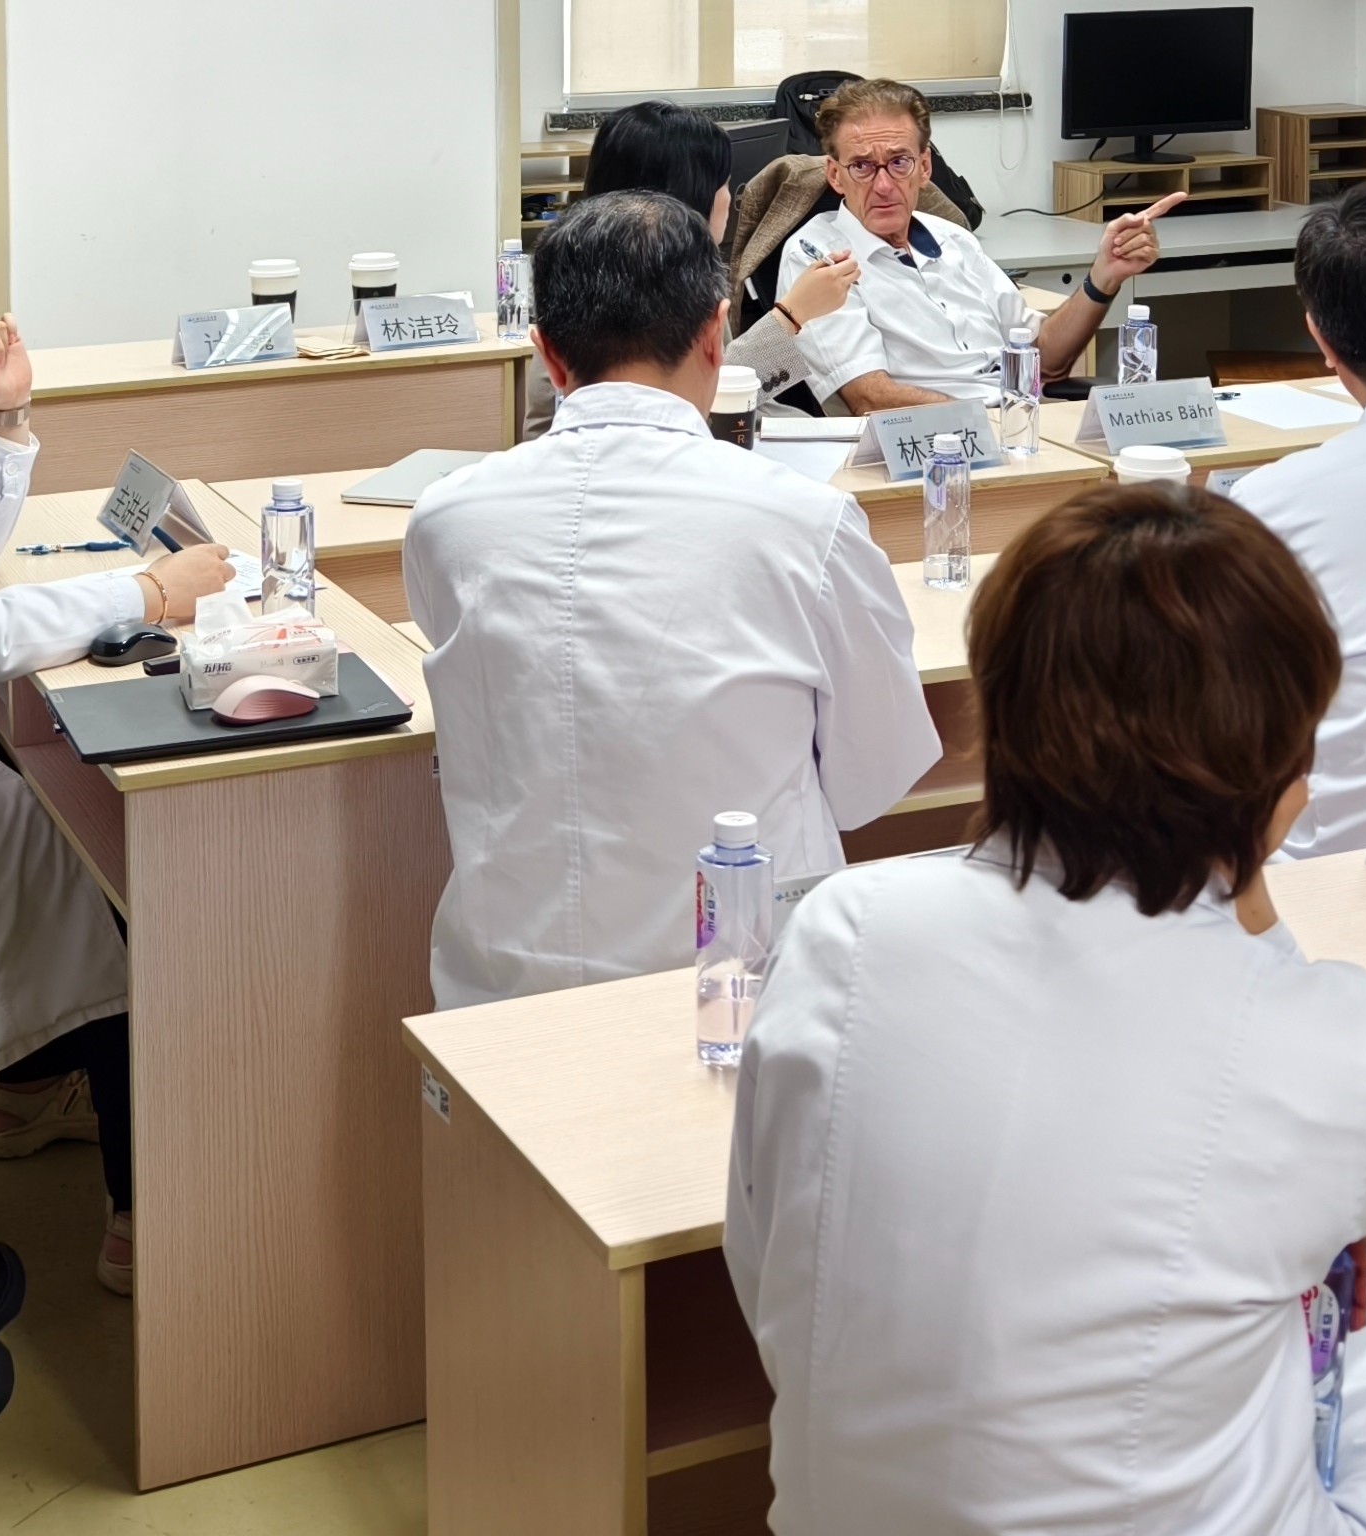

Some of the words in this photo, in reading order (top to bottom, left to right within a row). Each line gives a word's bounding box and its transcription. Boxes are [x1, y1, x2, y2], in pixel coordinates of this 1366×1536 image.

[381, 313, 459, 342] 林洁玲
[1108, 408, 1173, 427] Mathias
[1178, 403, 1214, 420] Bähr
[110, 485, 150, 536] 主讲台
